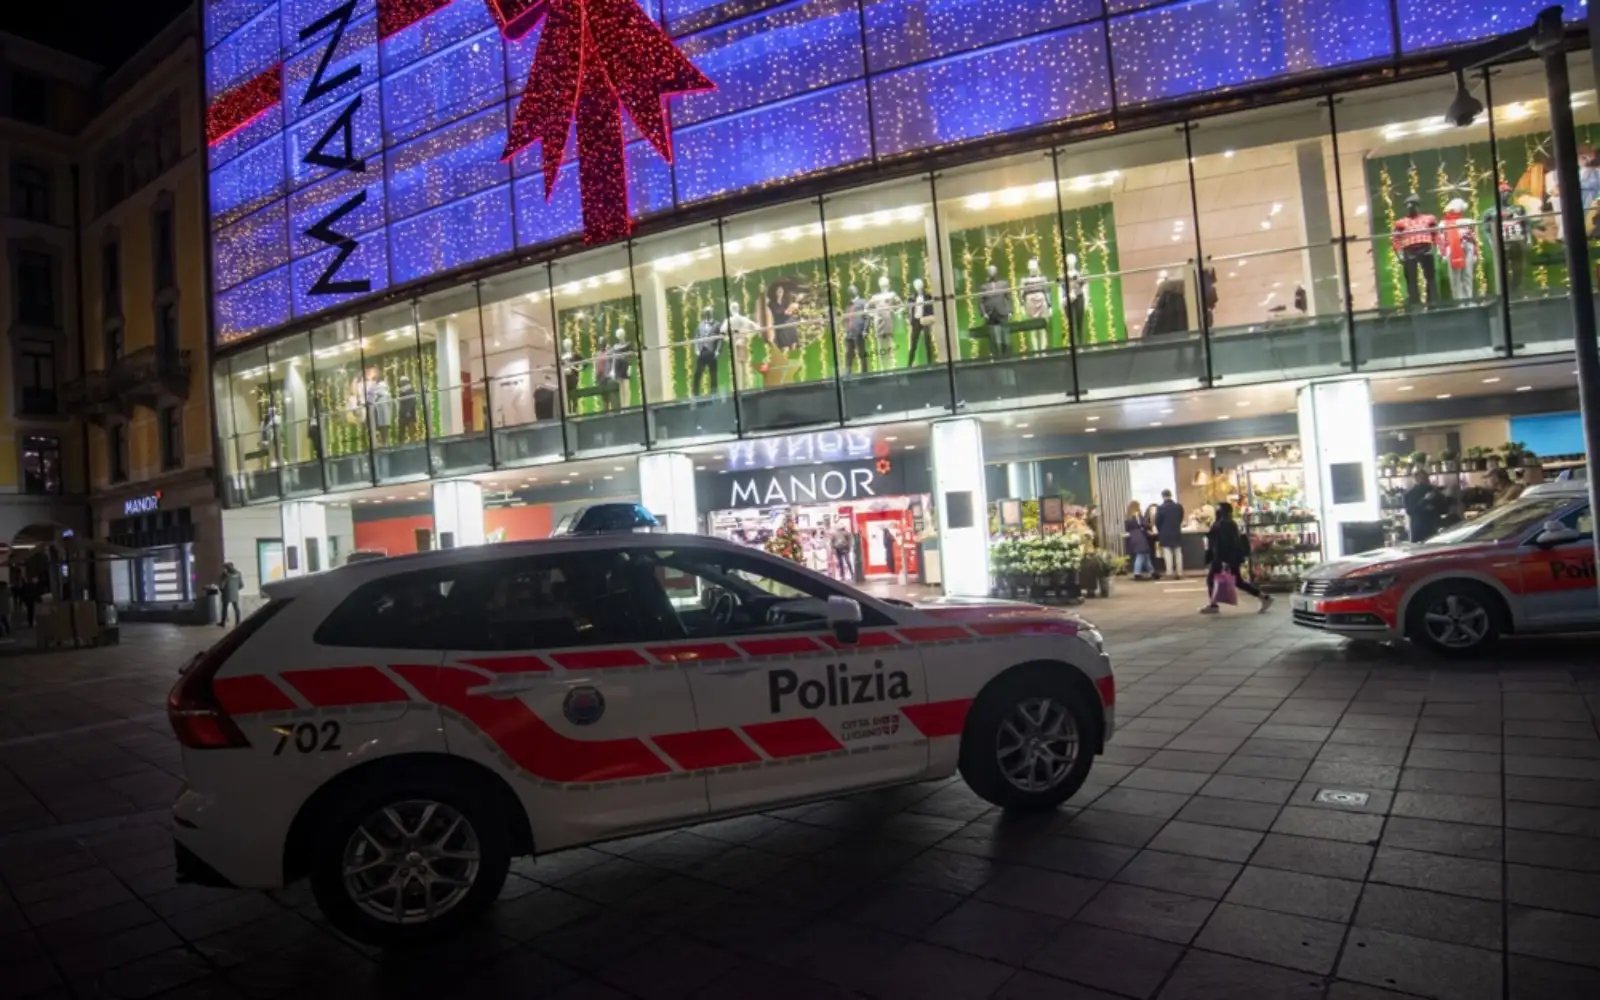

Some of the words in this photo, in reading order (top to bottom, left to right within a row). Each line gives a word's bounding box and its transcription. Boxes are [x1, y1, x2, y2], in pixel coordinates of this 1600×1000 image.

[299, 0, 371, 295] MAN
[123, 495, 158, 515] MANOR
[730, 468, 875, 507] MANOR
[768, 659, 912, 713] Polizia
[271, 720, 342, 756] 702
